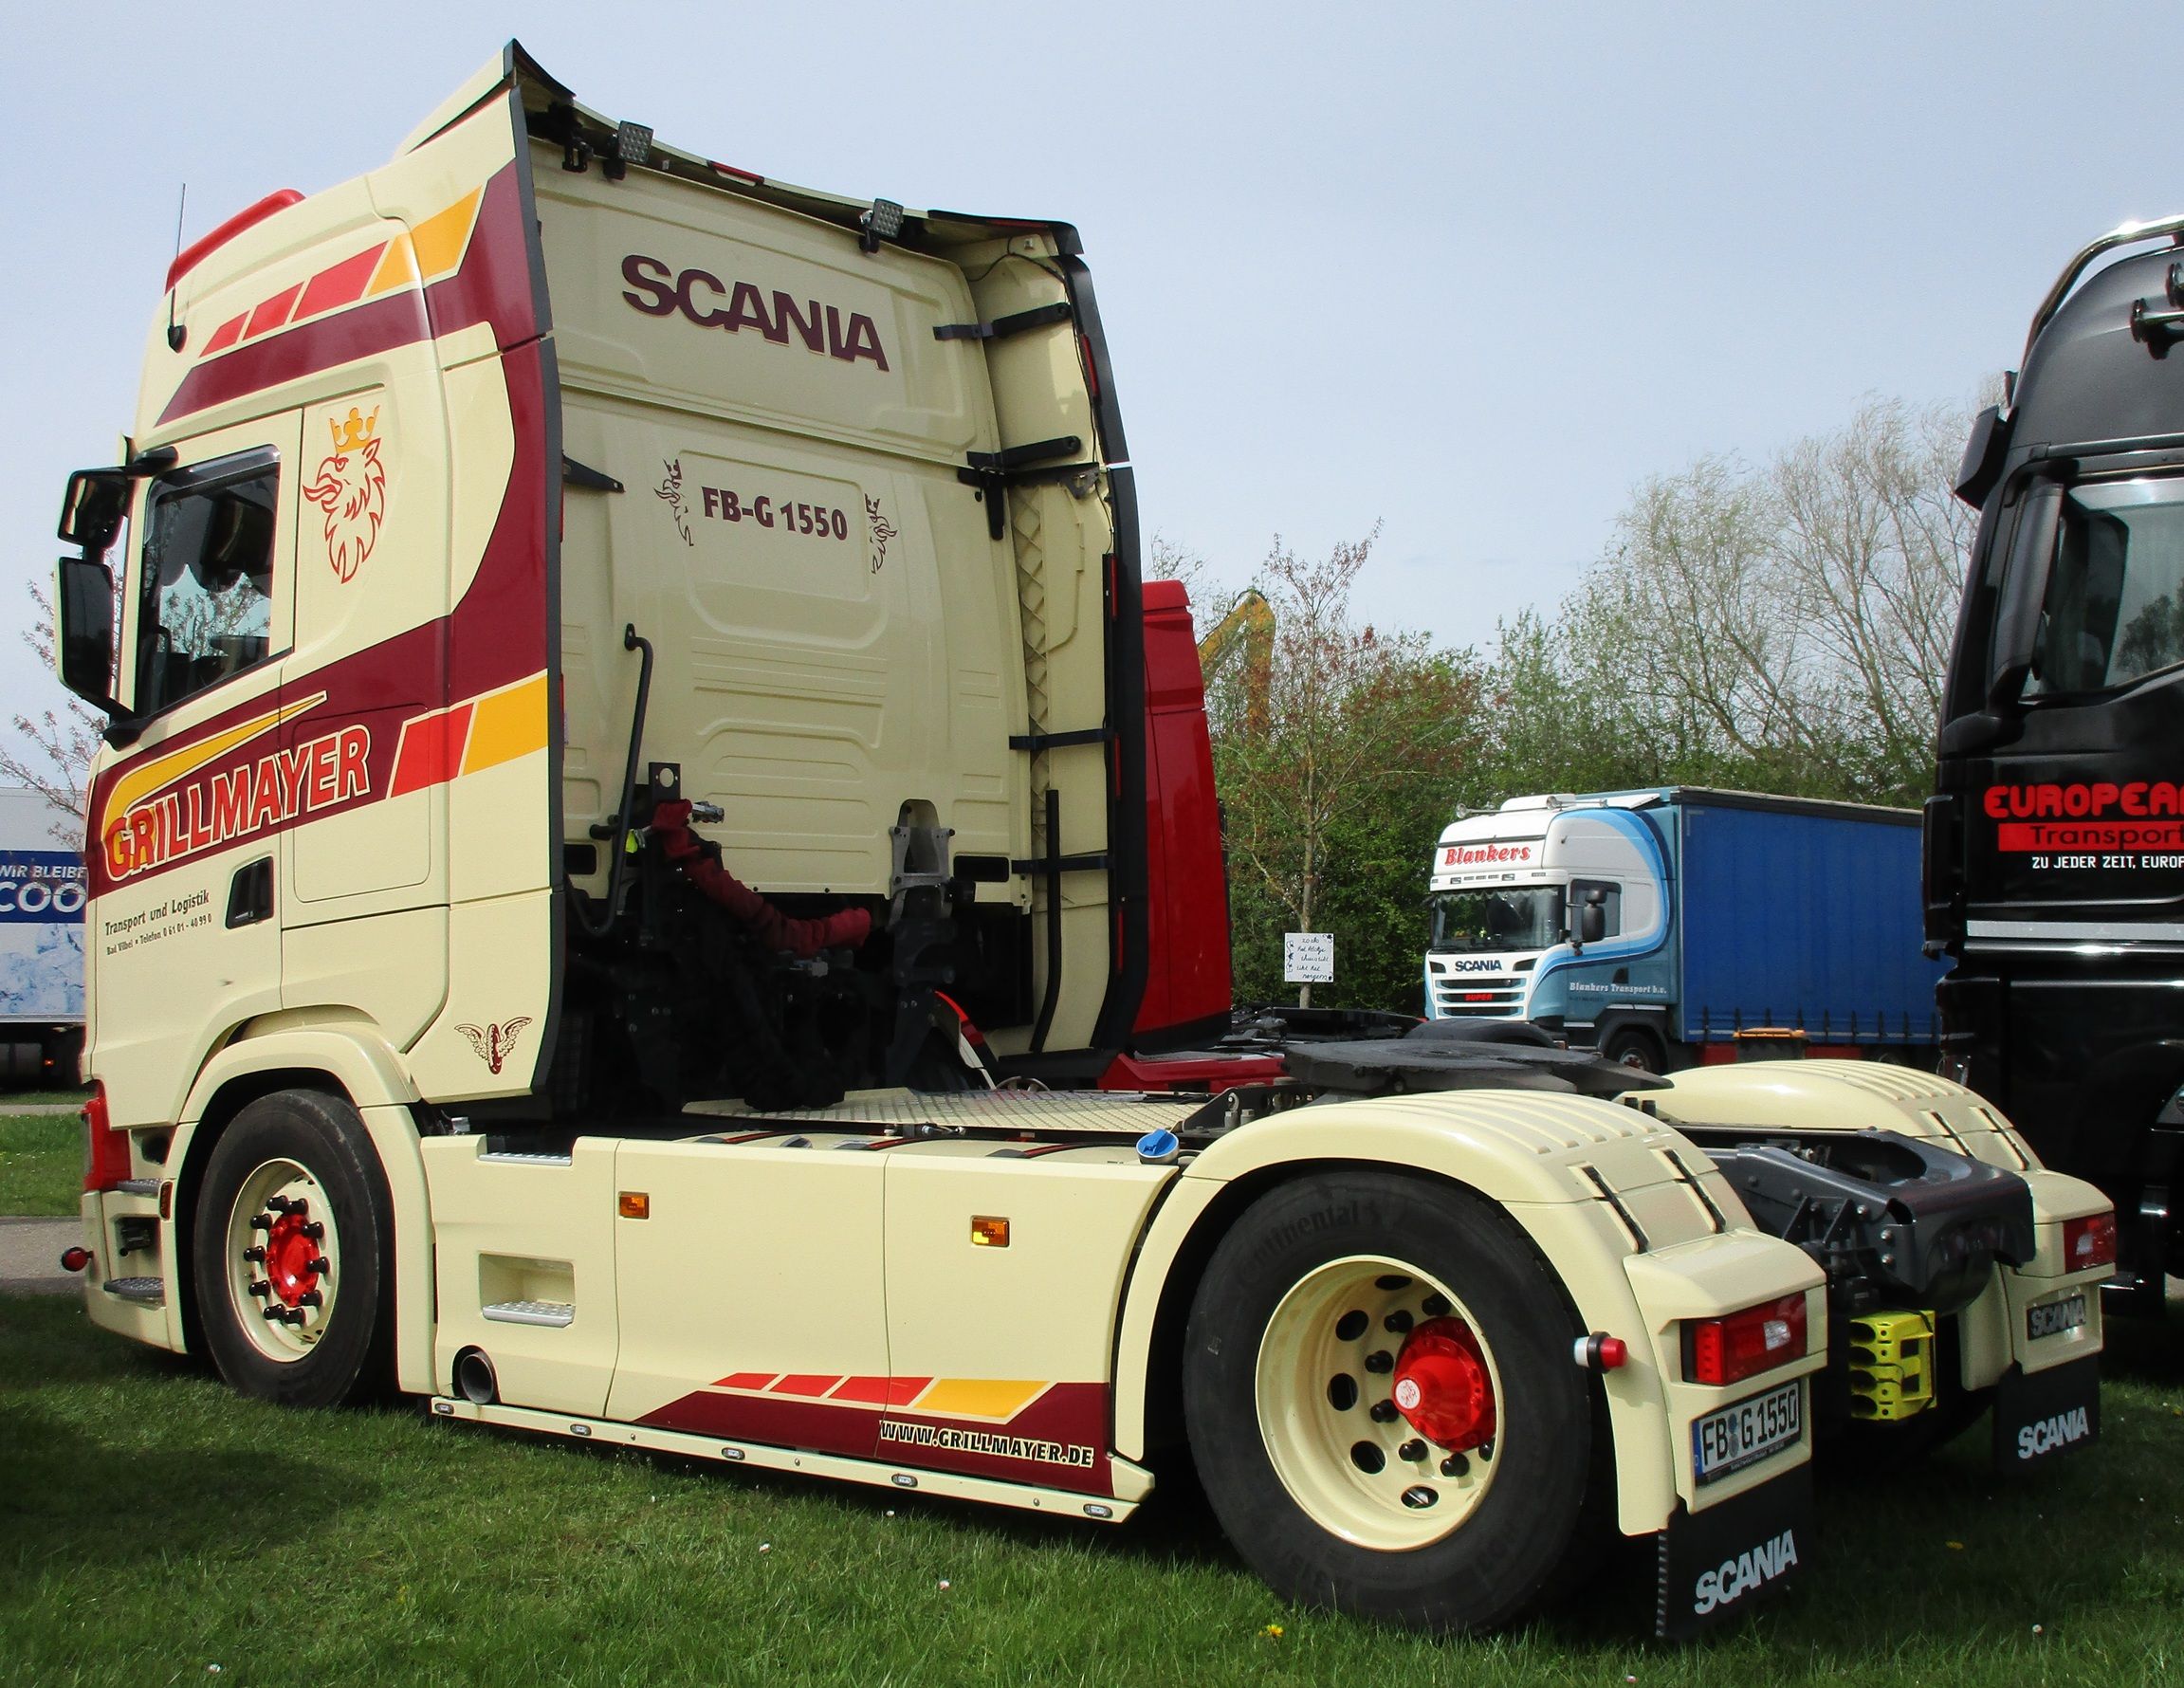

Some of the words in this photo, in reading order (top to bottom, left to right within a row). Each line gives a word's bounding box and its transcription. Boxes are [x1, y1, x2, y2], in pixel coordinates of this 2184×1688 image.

[621, 254, 890, 372] SCANIA
[701, 486, 775, 528] FB-G
[780, 501, 848, 541] 1550
[101, 724, 371, 881] GRILLMAYER
[1984, 781, 2184, 818] EUROPEA
[0, 865, 28, 878] WIR
[1444, 843, 1531, 866] Blankers
[2031, 856, 2048, 869] ZU
[2053, 856, 2096, 869] JEDER
[2102, 856, 2136, 870] ZEIT,
[105, 910, 146, 936] Transport
[150, 902, 167, 921] und
[172, 889, 210, 914] Logistik
[139, 931, 161, 944] Telefon
[1455, 960, 1502, 972] SCANIA
[1569, 982, 1608, 992] Blankers
[1610, 983, 1650, 995] Transport
[2031, 1298, 2085, 1336] SCANIA
[879, 1420, 1094, 1468] WWW.GRILLMAYER.DE
[1702, 1418, 1728, 1466] FB
[1741, 1407, 1753, 1449] G
[1757, 1389, 1797, 1443] 1550
[2018, 1406, 2089, 1459] SCANIA
[1695, 1529, 1798, 1615] SCANIA
